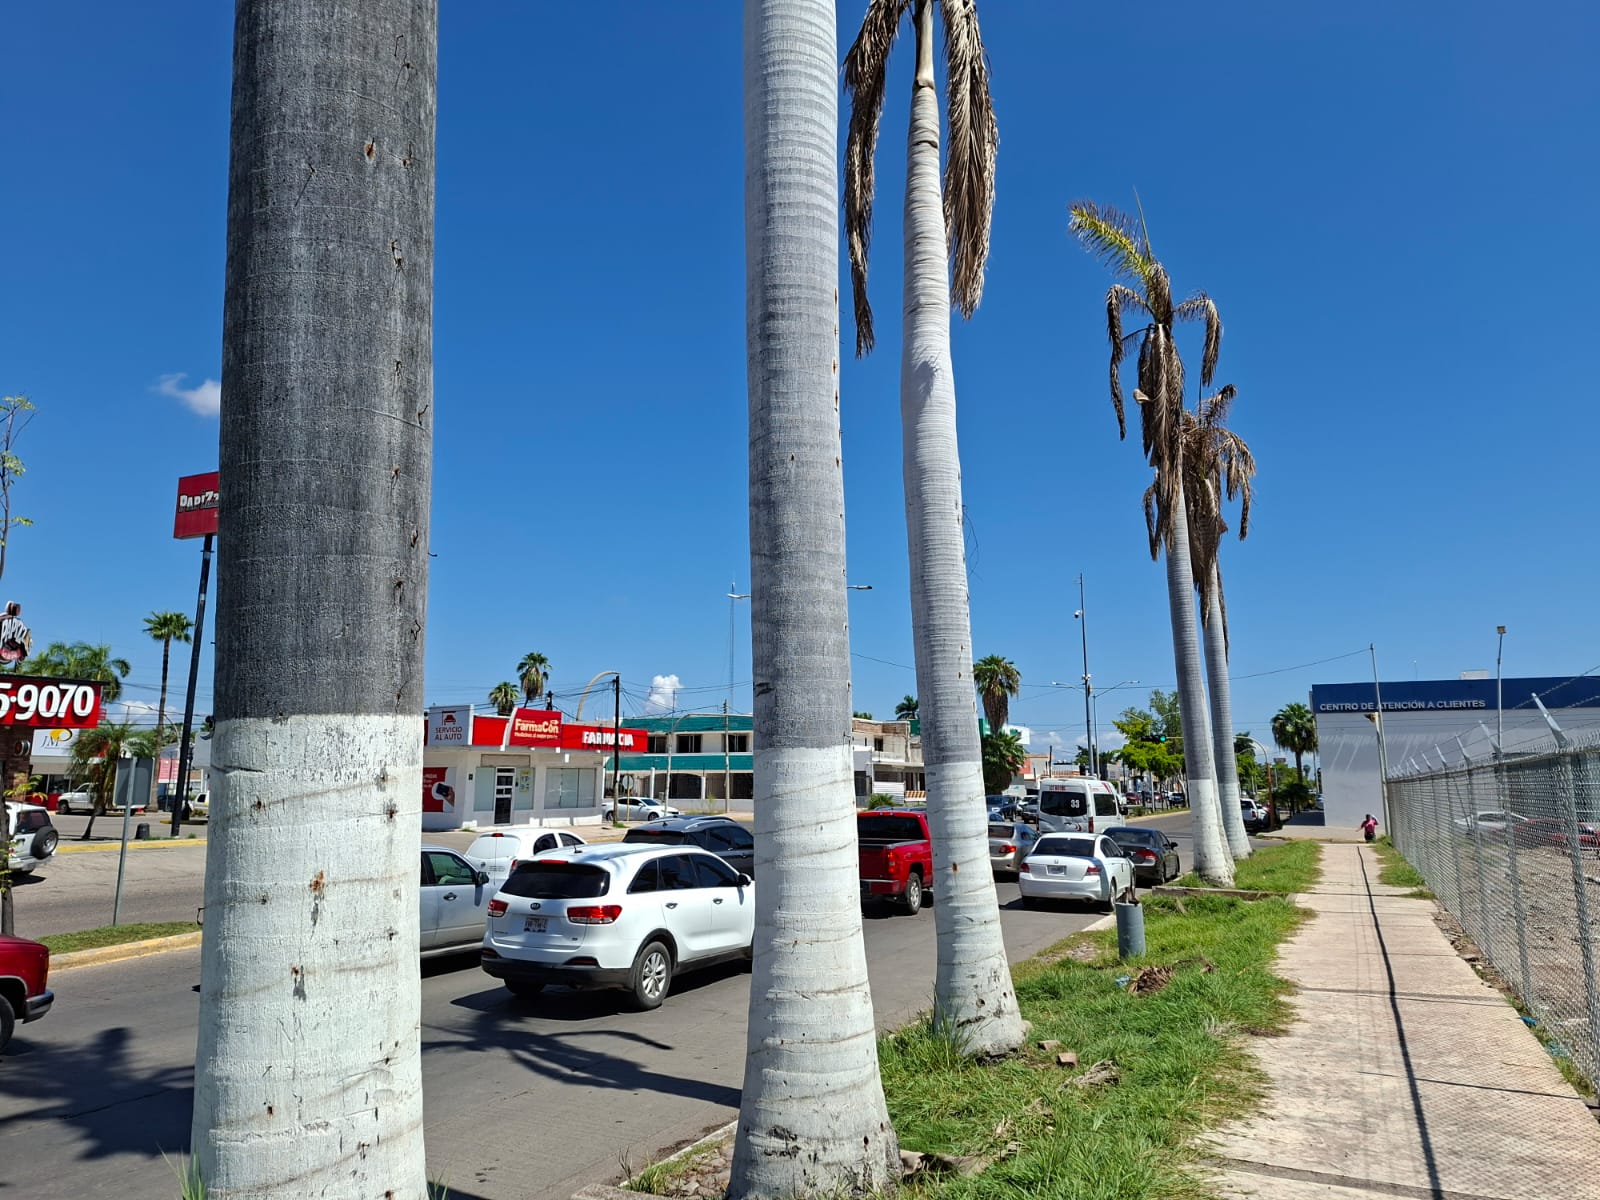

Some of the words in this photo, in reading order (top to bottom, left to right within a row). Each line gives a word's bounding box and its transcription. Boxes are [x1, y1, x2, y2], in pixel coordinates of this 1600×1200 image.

[1319, 702, 1358, 711] CENTRO
[1360, 702, 1376, 710] DE
[1427, 701, 1434, 709] A
[1436, 699, 1486, 709] CLIENTES
[1070, 799, 1080, 808] 33
